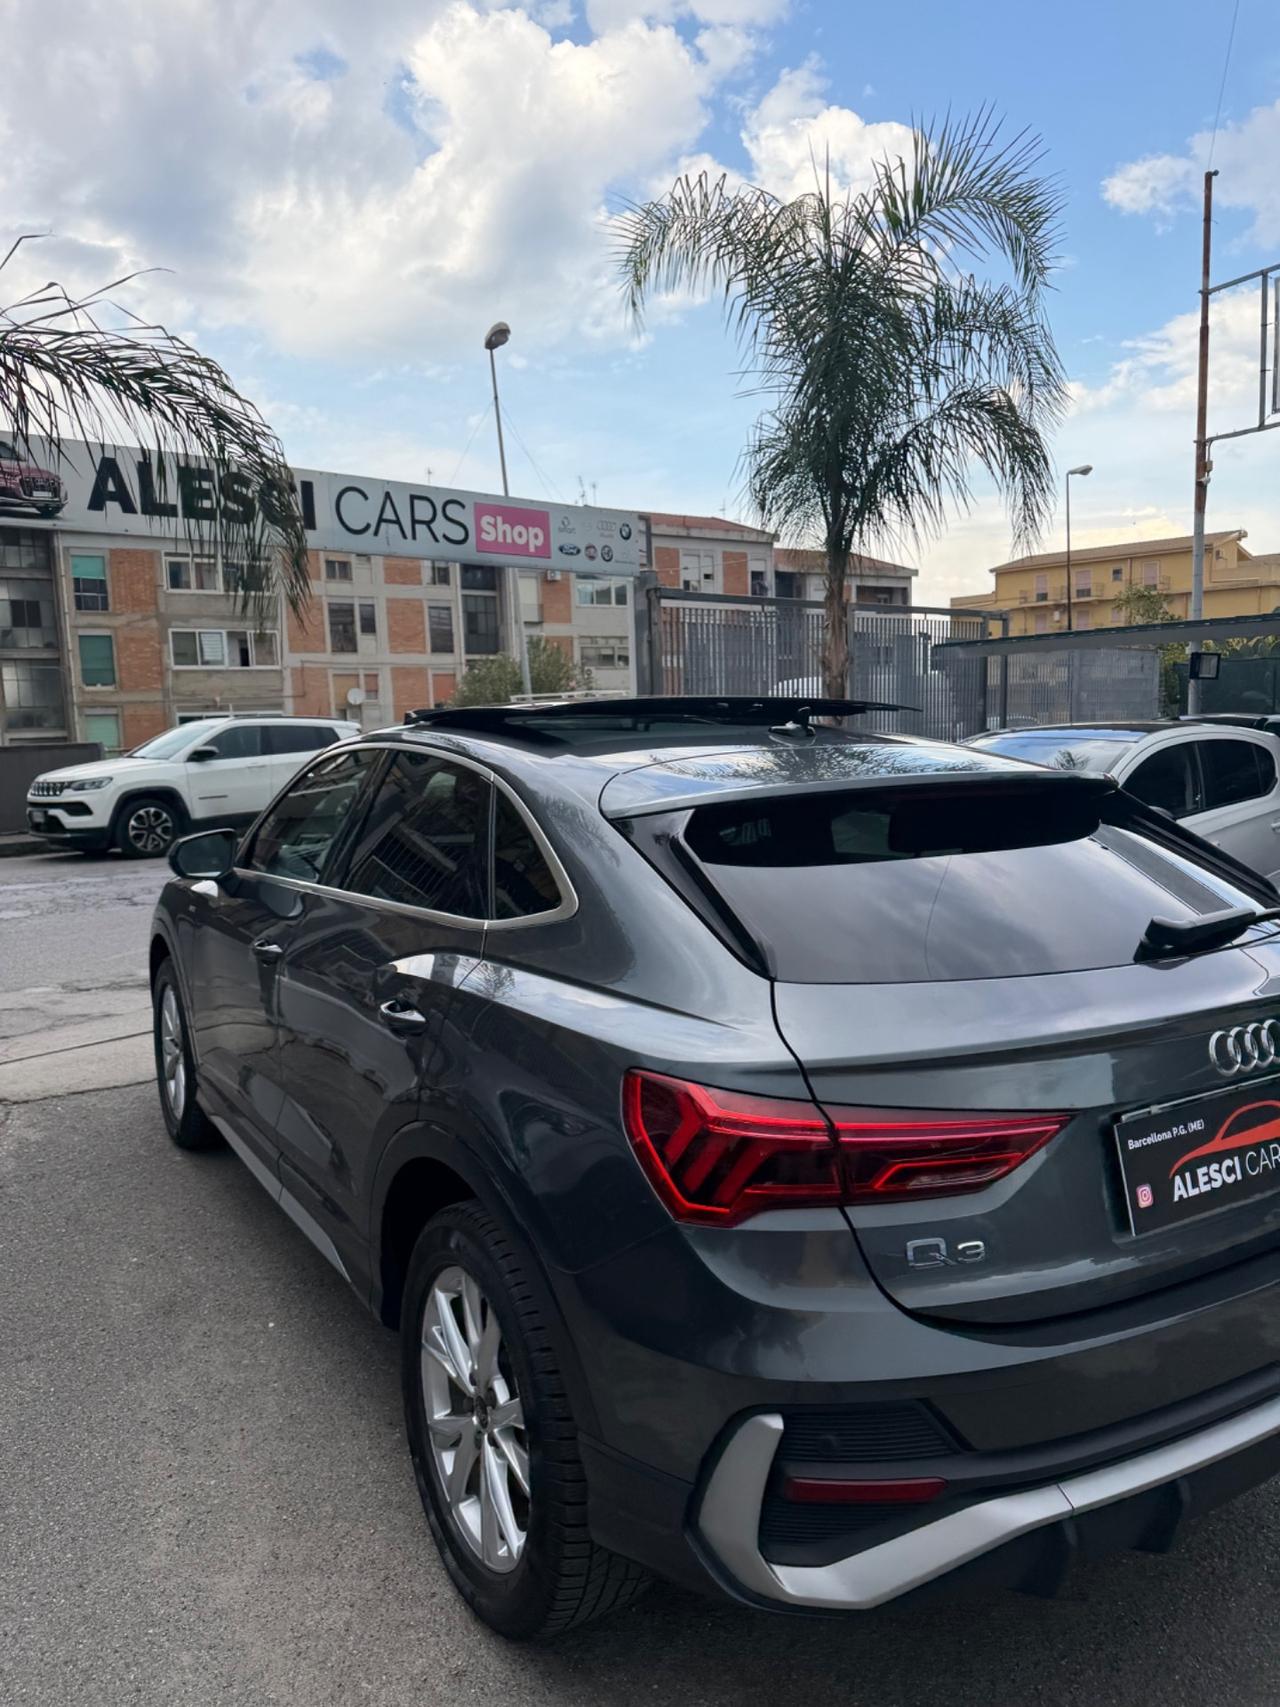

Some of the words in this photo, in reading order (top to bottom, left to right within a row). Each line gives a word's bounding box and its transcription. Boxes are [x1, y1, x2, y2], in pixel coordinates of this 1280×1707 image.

[335, 485, 470, 546] CARS
[480, 514, 544, 553] Shop
[1127, 1130, 1173, 1150] Barcellona
[1172, 1124, 1188, 1138] P.G.
[1187, 1118, 1205, 1133] (ME)
[1173, 1155, 1243, 1202] ALESCI
[906, 1237, 986, 1270] Q3
